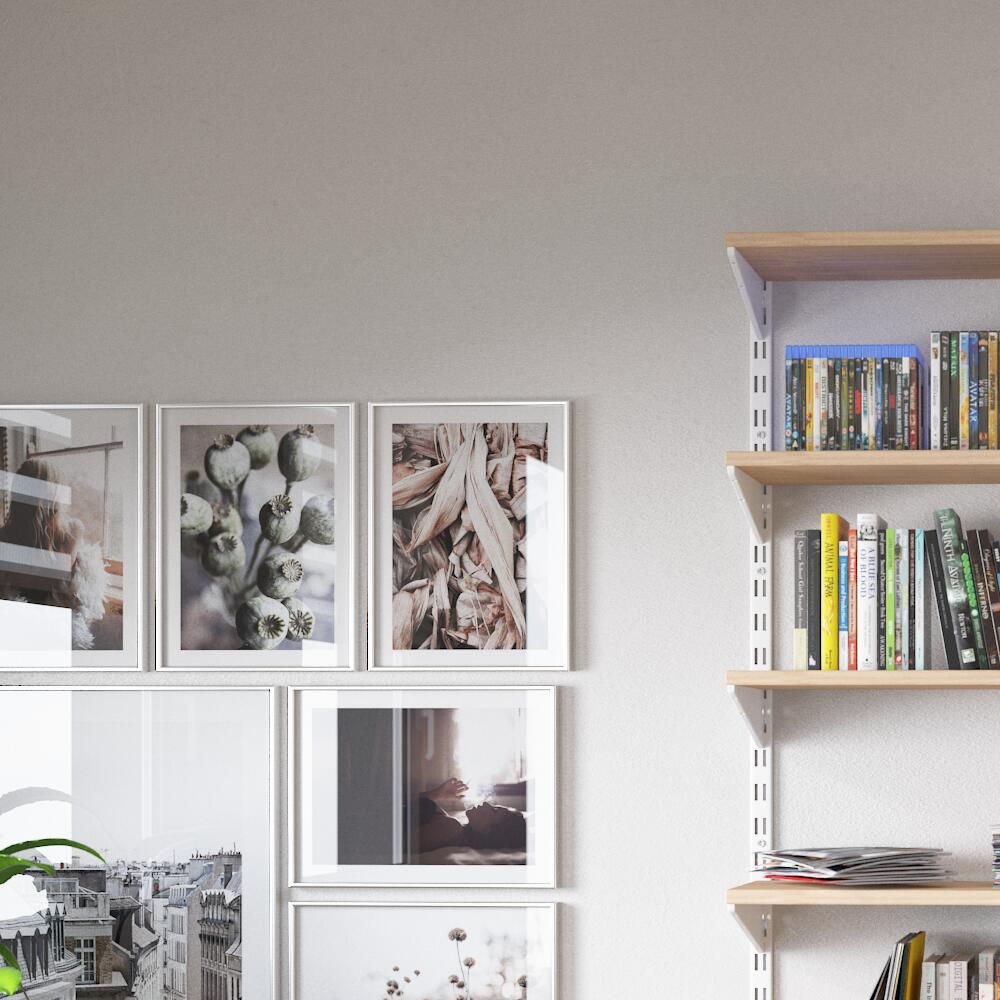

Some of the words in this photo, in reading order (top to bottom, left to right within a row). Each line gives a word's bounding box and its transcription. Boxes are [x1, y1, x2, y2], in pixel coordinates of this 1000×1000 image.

[825, 543, 835, 573] ANIMAL
[860, 549, 867, 560] OF
[943, 528, 957, 562] NINTH
[868, 557, 876, 581] BLUE
[825, 577, 835, 598] FARM
[868, 583, 876, 599] SEA
[977, 582, 989, 619] INFERNO
[954, 961, 963, 992] DIGITAL
